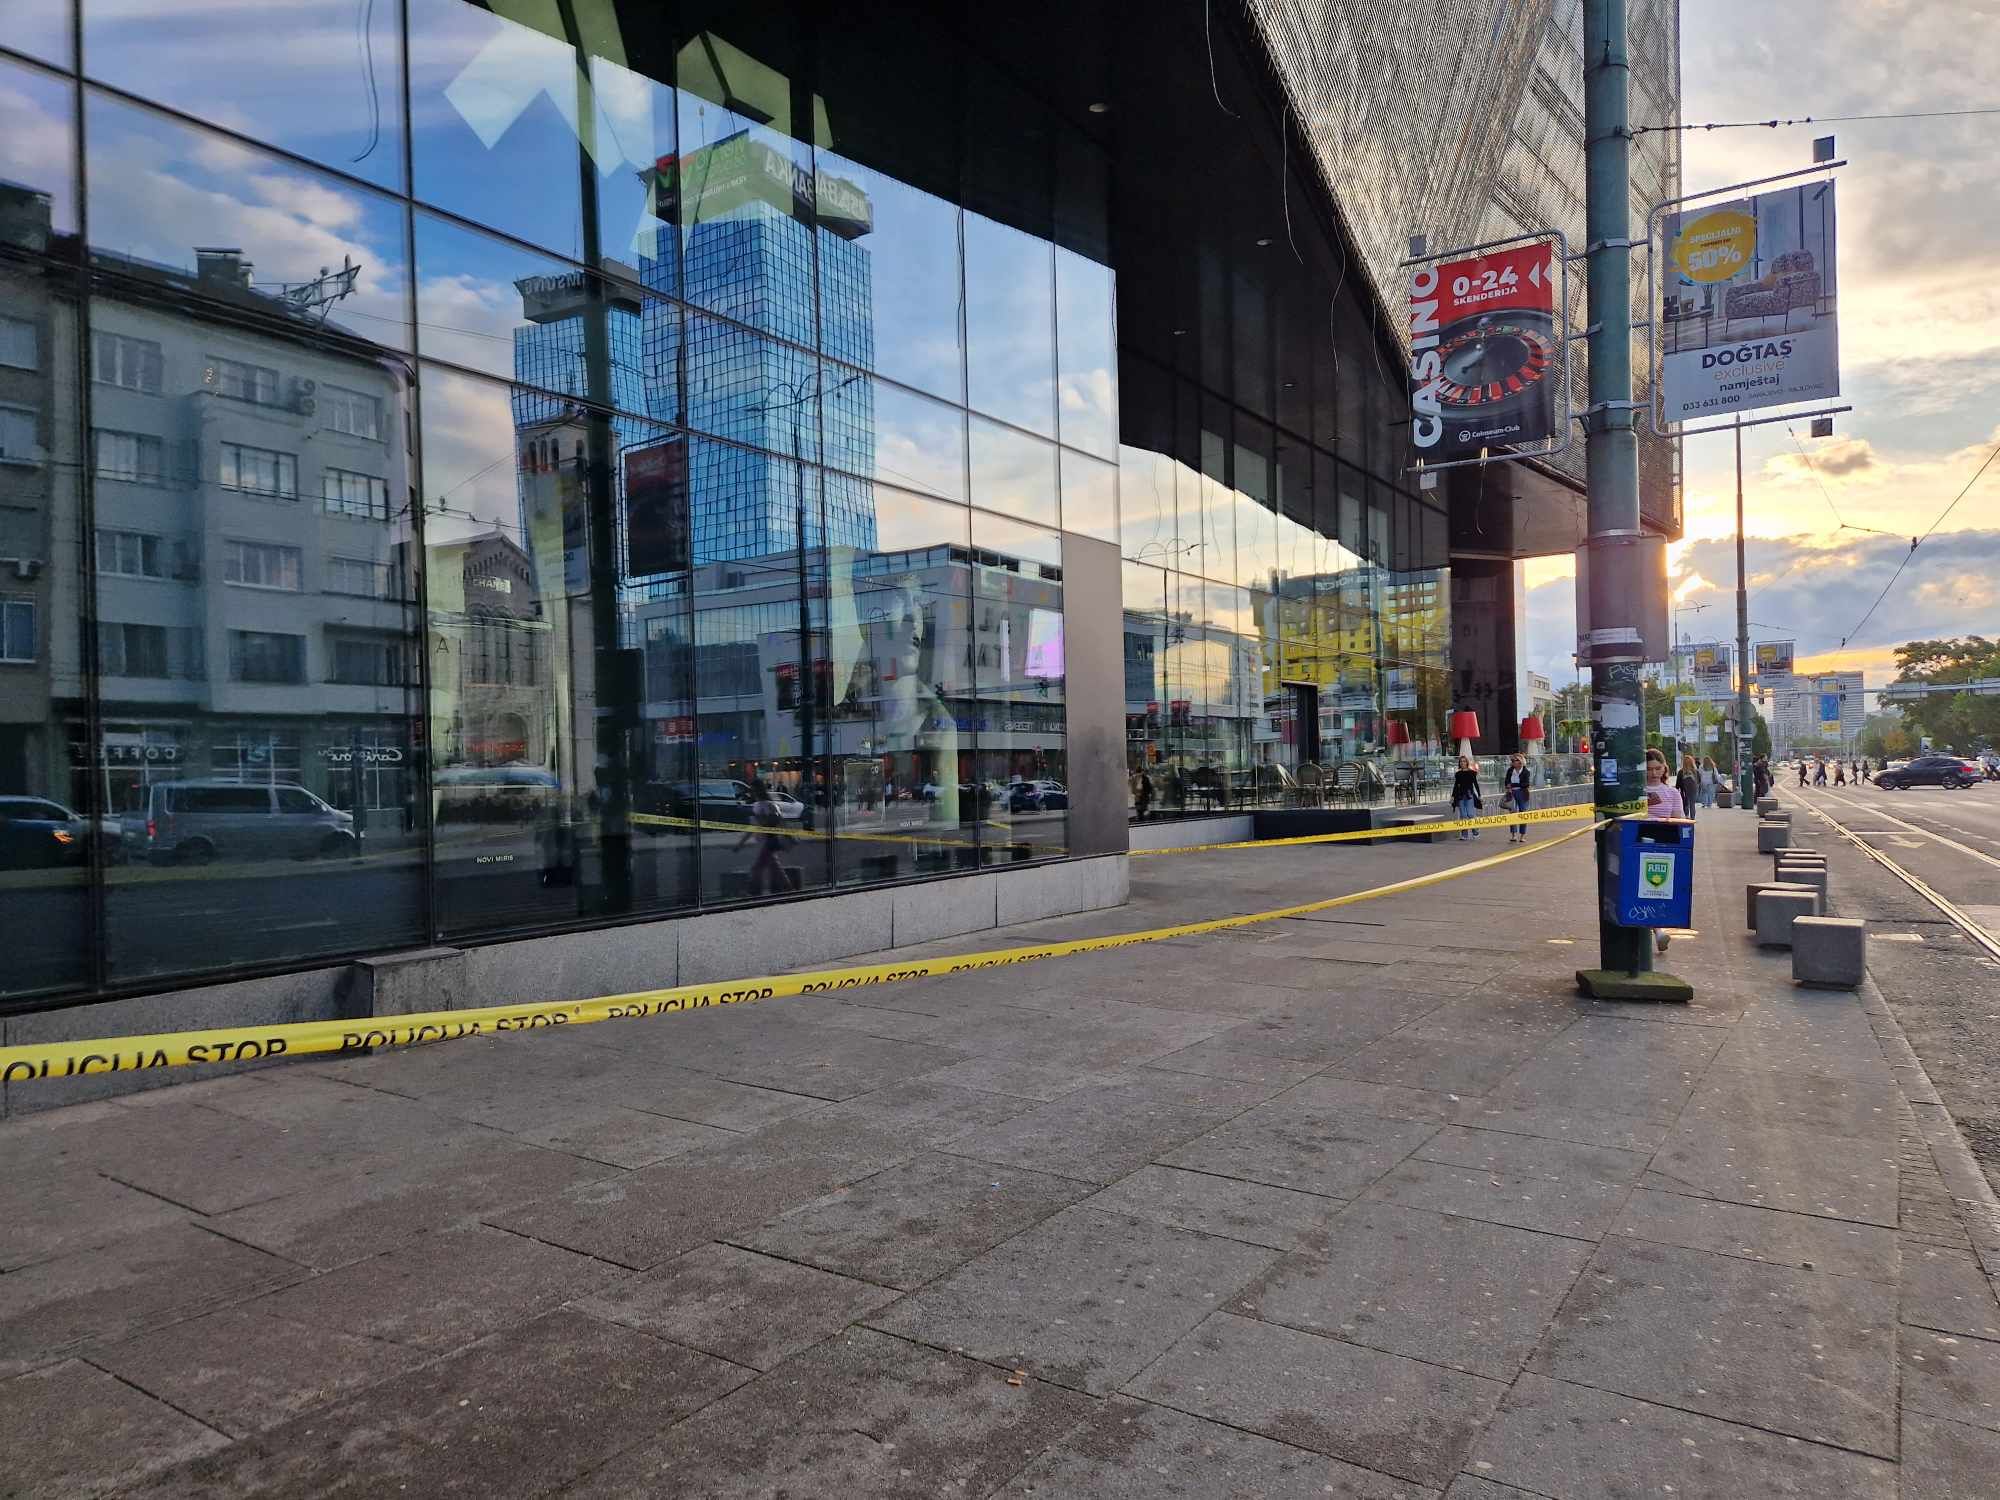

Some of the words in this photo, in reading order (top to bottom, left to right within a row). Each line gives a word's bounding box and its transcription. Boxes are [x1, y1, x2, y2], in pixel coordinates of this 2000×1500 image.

[1688, 243, 1742, 272] 50%
[1452, 265, 1519, 297] 0-24
[1453, 286, 1518, 306] SKENDERIJA
[1410, 266, 1442, 448] CASINO
[1713, 359, 1785, 381] exclusive
[1719, 373, 1780, 391] namještaj
[1682, 400, 1700, 411] 033
[1703, 398, 1719, 409] 631
[1721, 394, 1740, 405] 800
[719, 986, 775, 1006] STOP
[496, 1012, 569, 1031] STOP
[2, 1049, 170, 1082] OLICIJA
[187, 1037, 288, 1065] STOP
